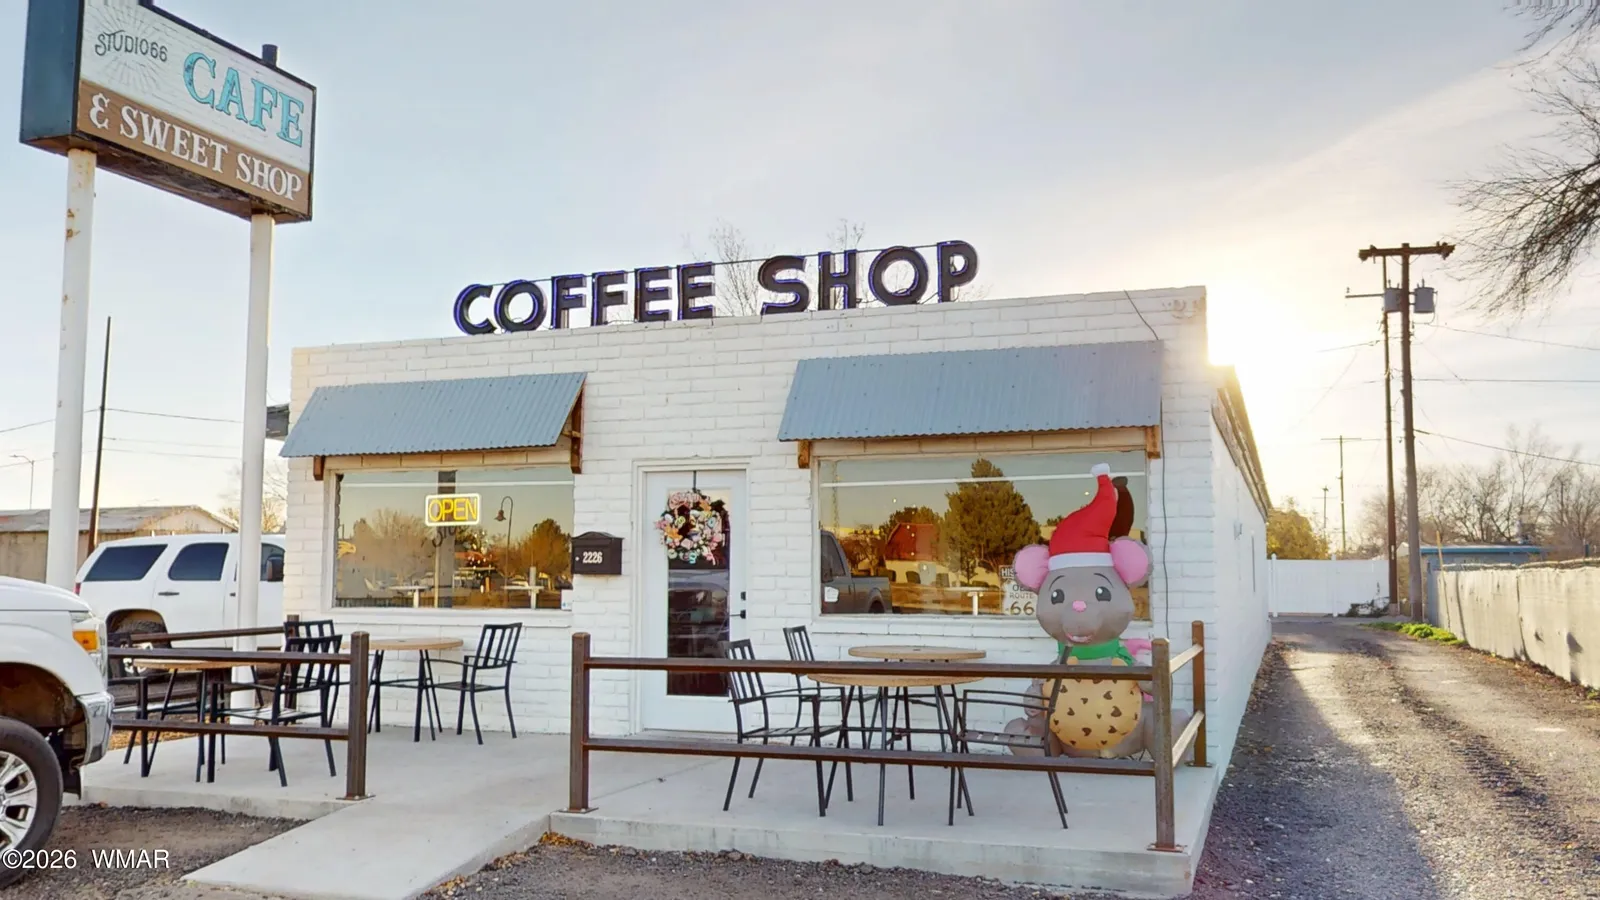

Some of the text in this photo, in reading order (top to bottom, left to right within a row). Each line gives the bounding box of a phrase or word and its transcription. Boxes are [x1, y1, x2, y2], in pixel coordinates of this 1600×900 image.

[183, 52, 304, 147] CAFE
[120, 104, 228, 174] SWEET
[236, 153, 302, 201] SHOP
[453, 240, 978, 335] COFFEE SHOP
[428, 498, 477, 522] OPEN
[582, 551, 603, 564] 2226
[1010, 601, 1035, 616] 66
